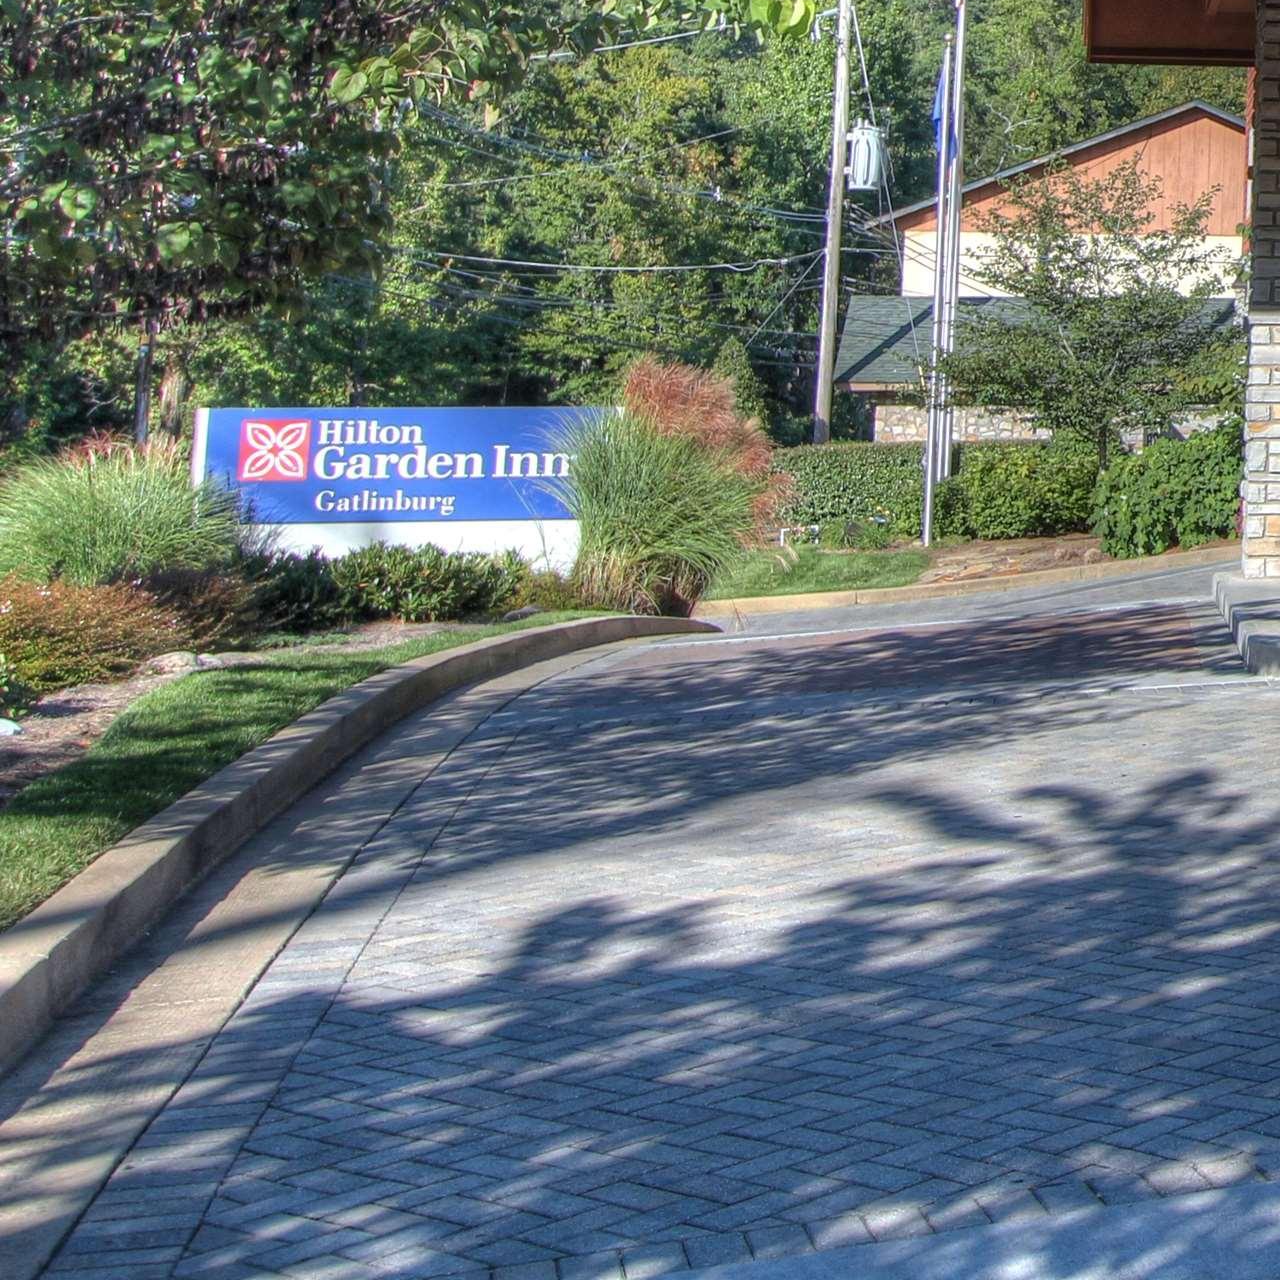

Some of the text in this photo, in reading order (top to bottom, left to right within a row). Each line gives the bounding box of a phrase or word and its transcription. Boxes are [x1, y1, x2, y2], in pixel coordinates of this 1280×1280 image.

[318, 420, 423, 445] Hilton
[313, 444, 570, 480] Garden Inn
[314, 489, 456, 516] Gatlinburg
